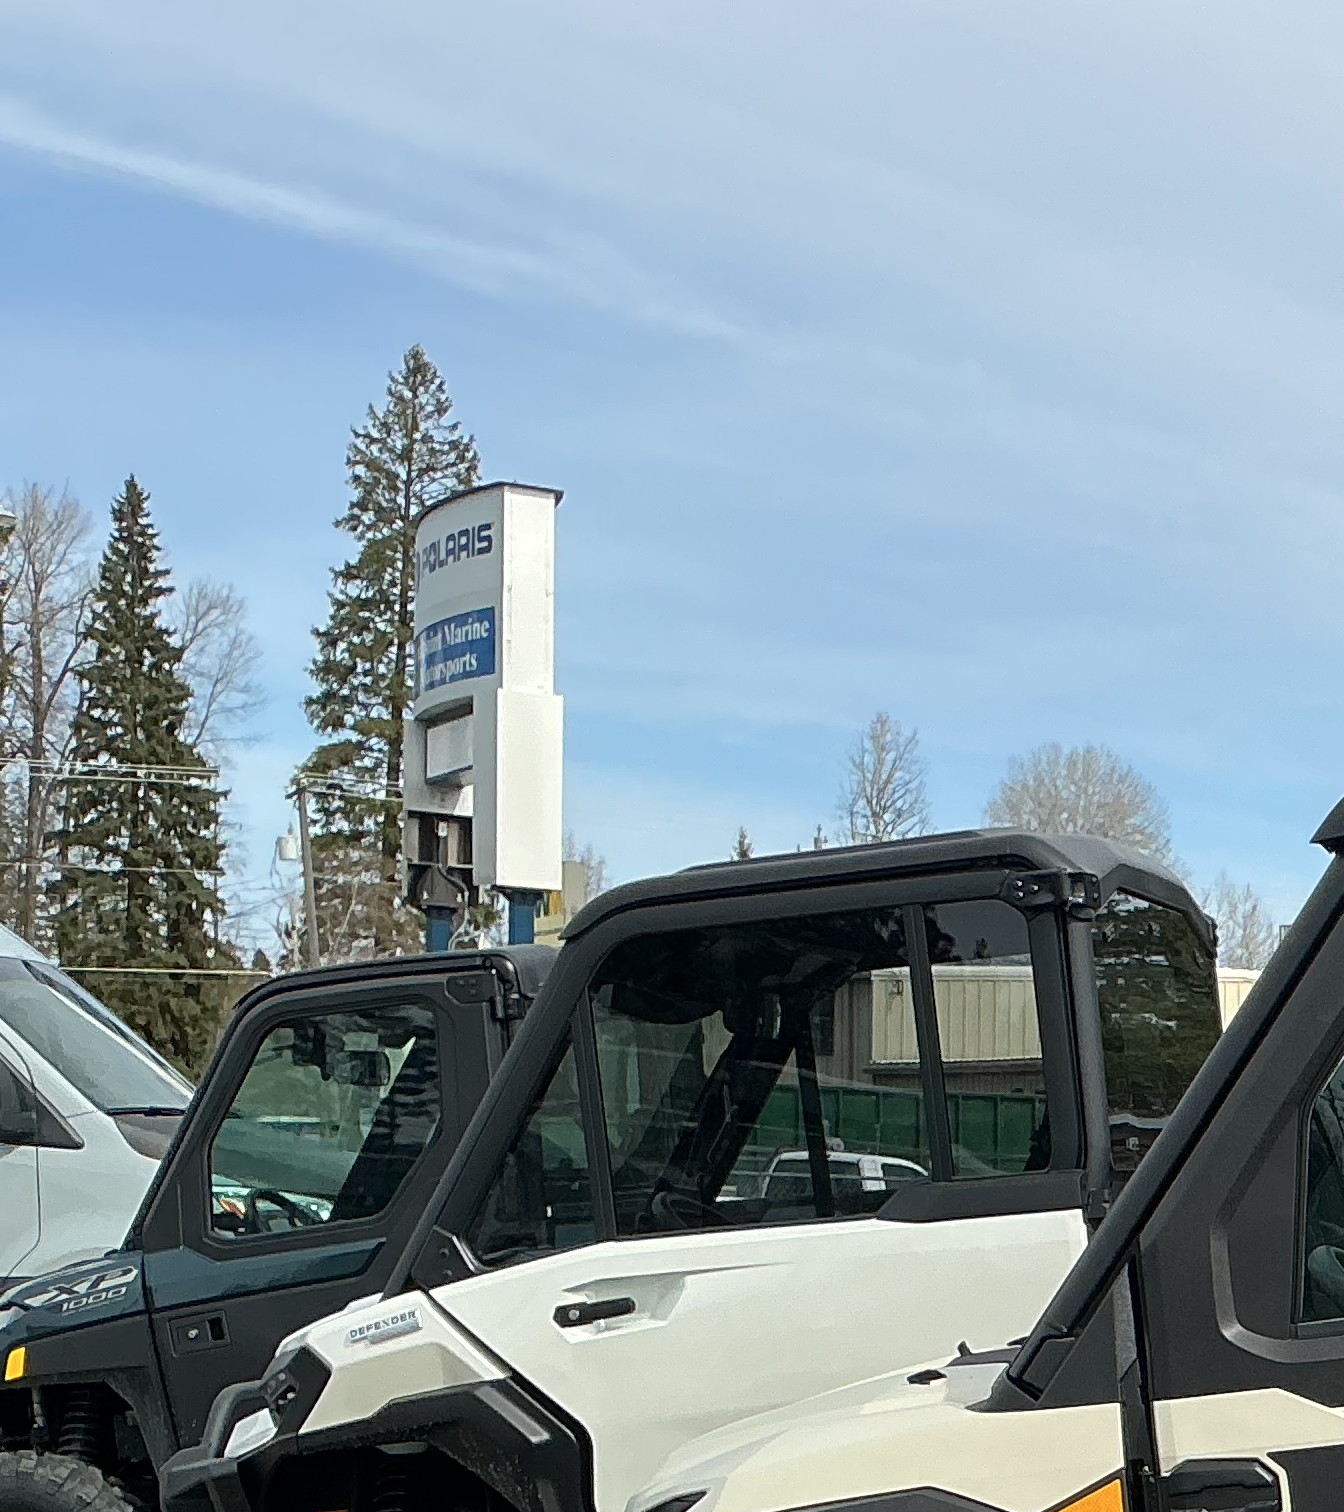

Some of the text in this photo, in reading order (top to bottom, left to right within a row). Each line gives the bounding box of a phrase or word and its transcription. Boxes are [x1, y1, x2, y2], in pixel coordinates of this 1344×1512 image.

[422, 522, 494, 576] POLARIS
[444, 617, 491, 646] Marine
[61, 1286, 128, 1313] 1000
[349, 1309, 417, 1339] DEFENDER
